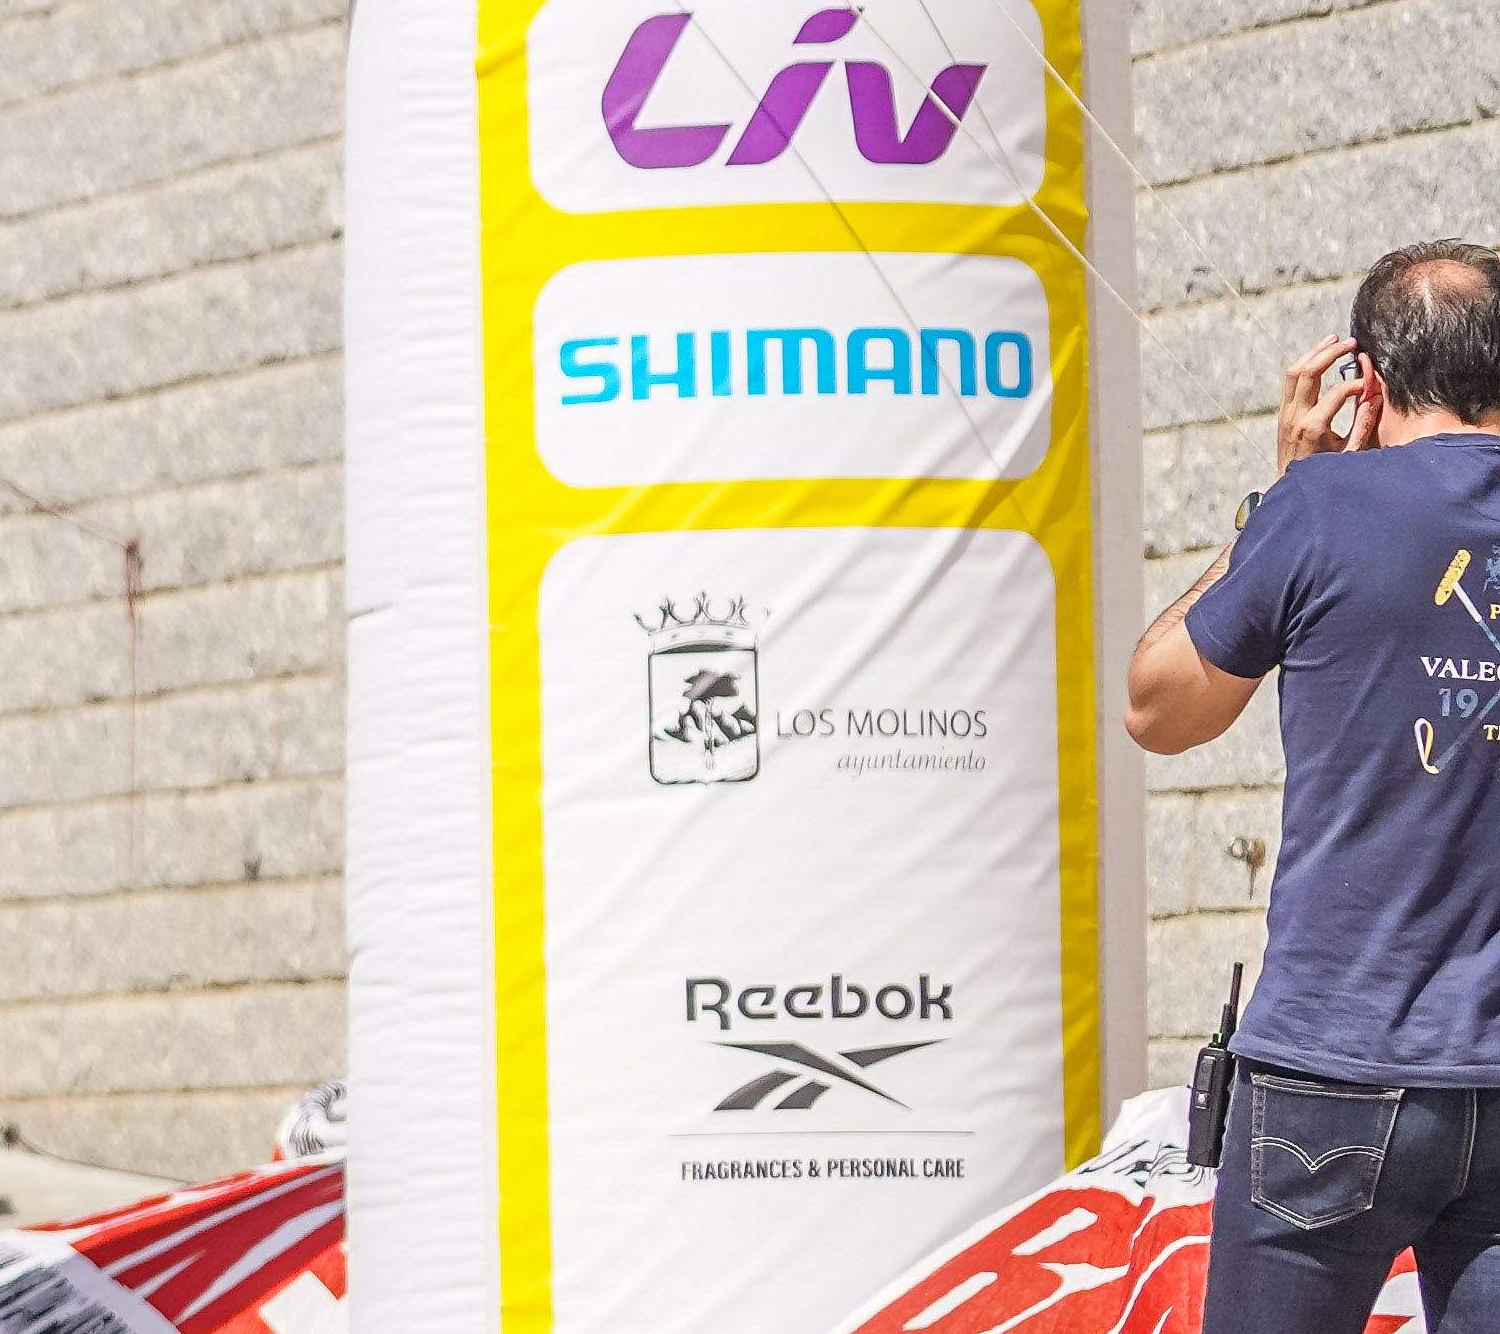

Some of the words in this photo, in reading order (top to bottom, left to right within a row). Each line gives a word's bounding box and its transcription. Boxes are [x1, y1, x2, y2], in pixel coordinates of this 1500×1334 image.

[560, 327, 1034, 406] SHIMANO
[1420, 656, 1500, 683] VALE
[776, 708, 835, 738] LOS
[846, 707, 989, 738] MOLINOS
[837, 745, 987, 777] ayuntamiento
[686, 973, 954, 1031] Reebok
[681, 1158, 802, 1181] FRAGRANCES
[807, 1158, 822, 1179] &
[827, 1158, 920, 1180] PERSONAL
[923, 1157, 966, 1179] CARE
